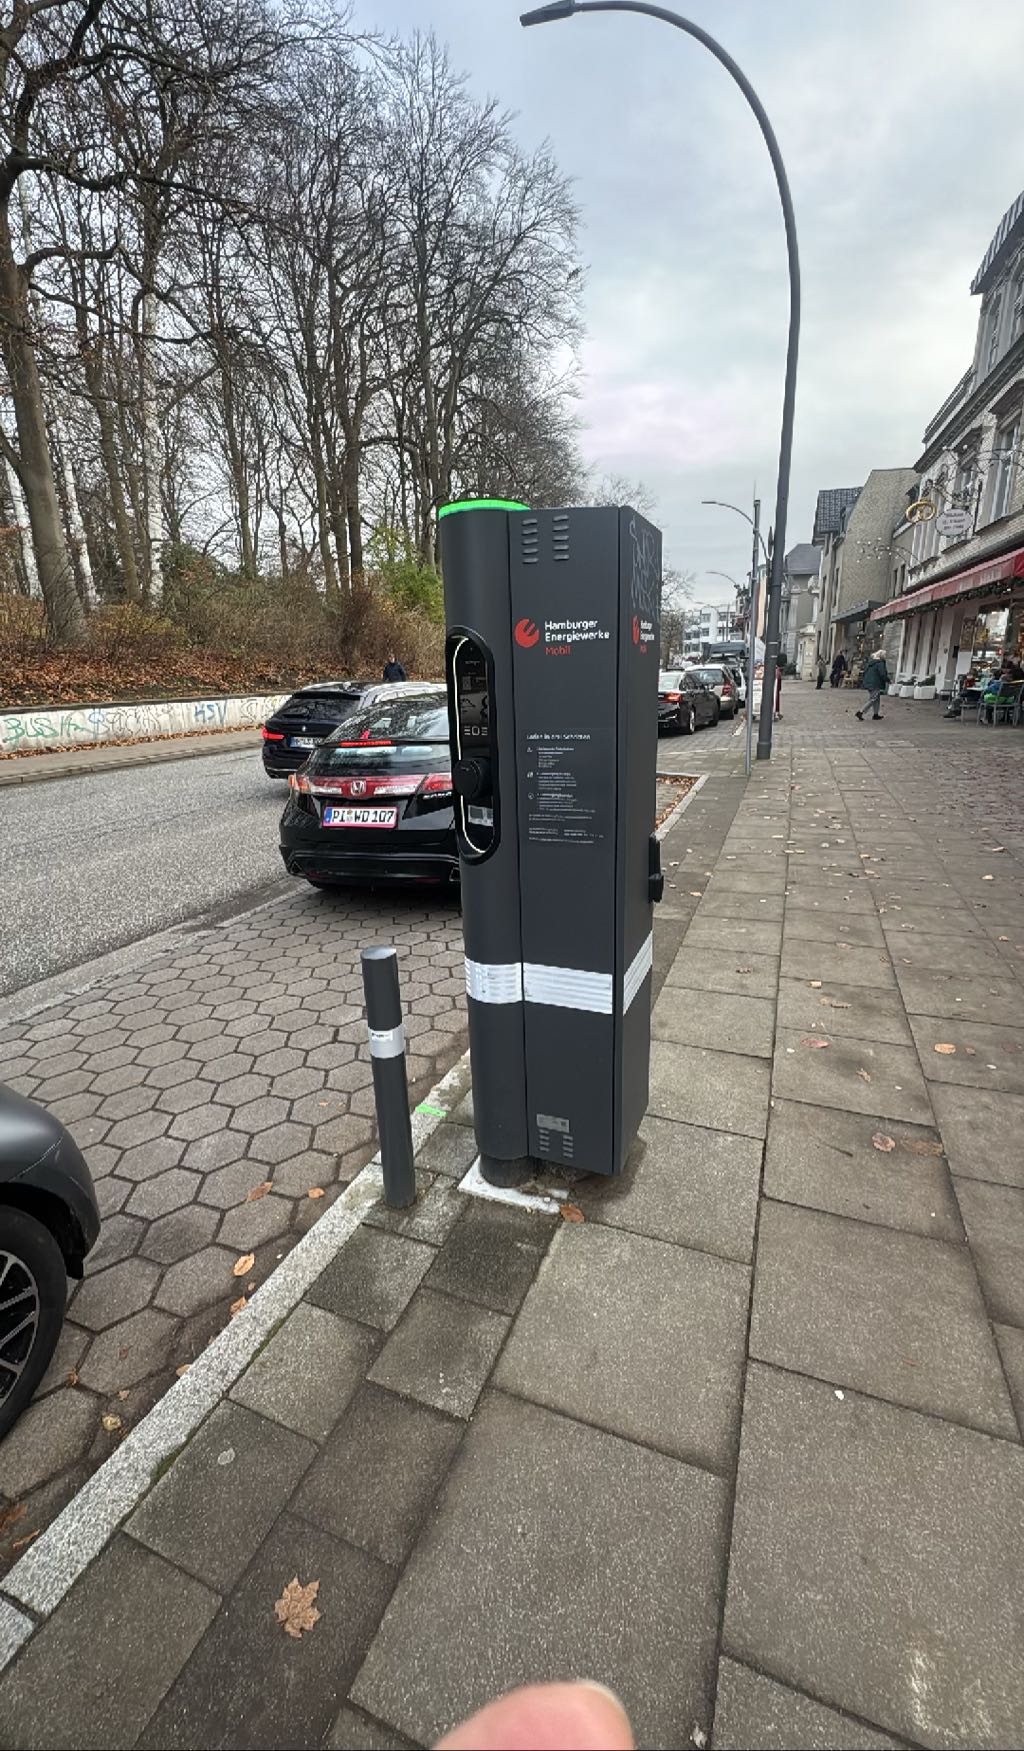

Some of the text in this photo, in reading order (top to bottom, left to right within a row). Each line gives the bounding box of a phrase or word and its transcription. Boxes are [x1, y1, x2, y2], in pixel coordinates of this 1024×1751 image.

[544, 619, 598, 630] Hamburger
[545, 630, 610, 643] Energiewerke
[545, 646, 571, 655] Mobil
[194, 703, 227, 727] HSV
[333, 811, 346, 822] PI
[372, 811, 394, 822] 107
